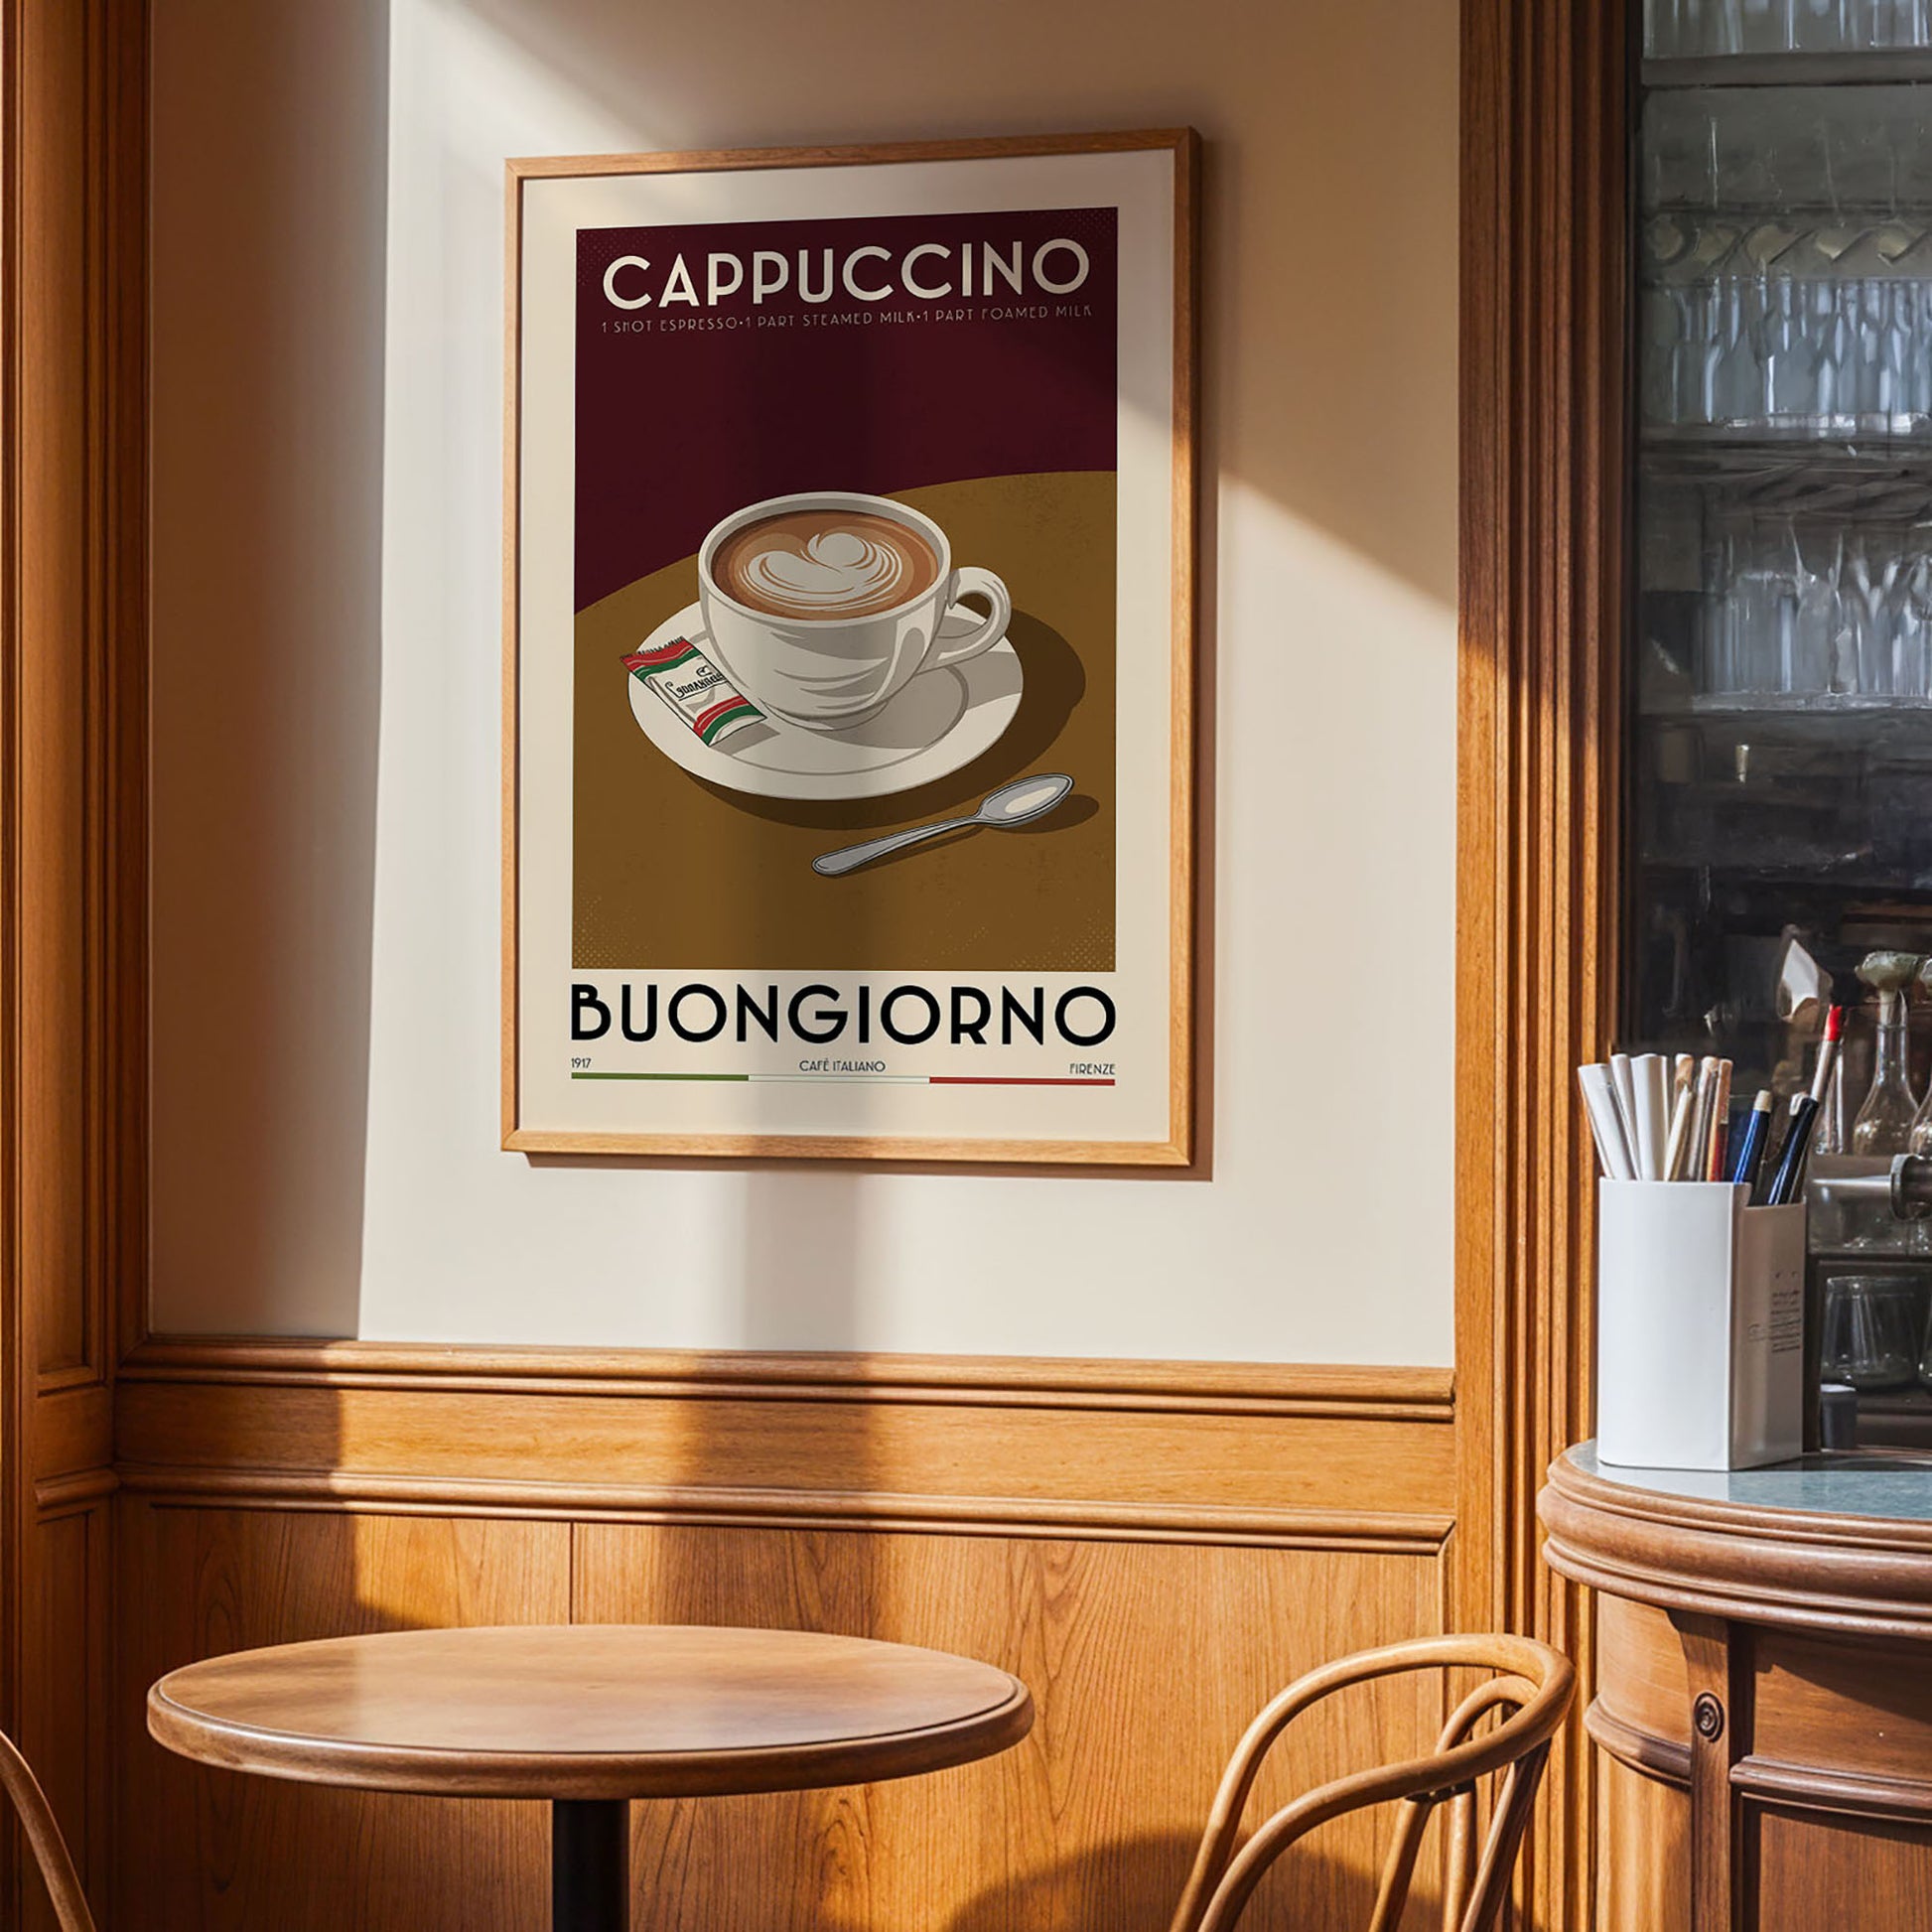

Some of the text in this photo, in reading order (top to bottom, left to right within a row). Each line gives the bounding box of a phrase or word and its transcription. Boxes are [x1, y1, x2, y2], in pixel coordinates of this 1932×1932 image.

[603, 238, 1090, 310] CAPPUCCINO
[602, 322, 608, 333] 1
[614, 320, 652, 333] SHOT
[758, 315, 794, 328] PART
[803, 312, 873, 326] STEAMED
[935, 309, 974, 322] PART
[981, 306, 1048, 320] FOAMED
[1055, 304, 1092, 317] MILK
[571, 983, 1116, 1046] BUONGIORNO
[571, 1057, 592, 1068] 1917
[798, 1058, 886, 1072] CAFÉ ITALIANO
[1069, 1063, 1116, 1075] FIRENZE
